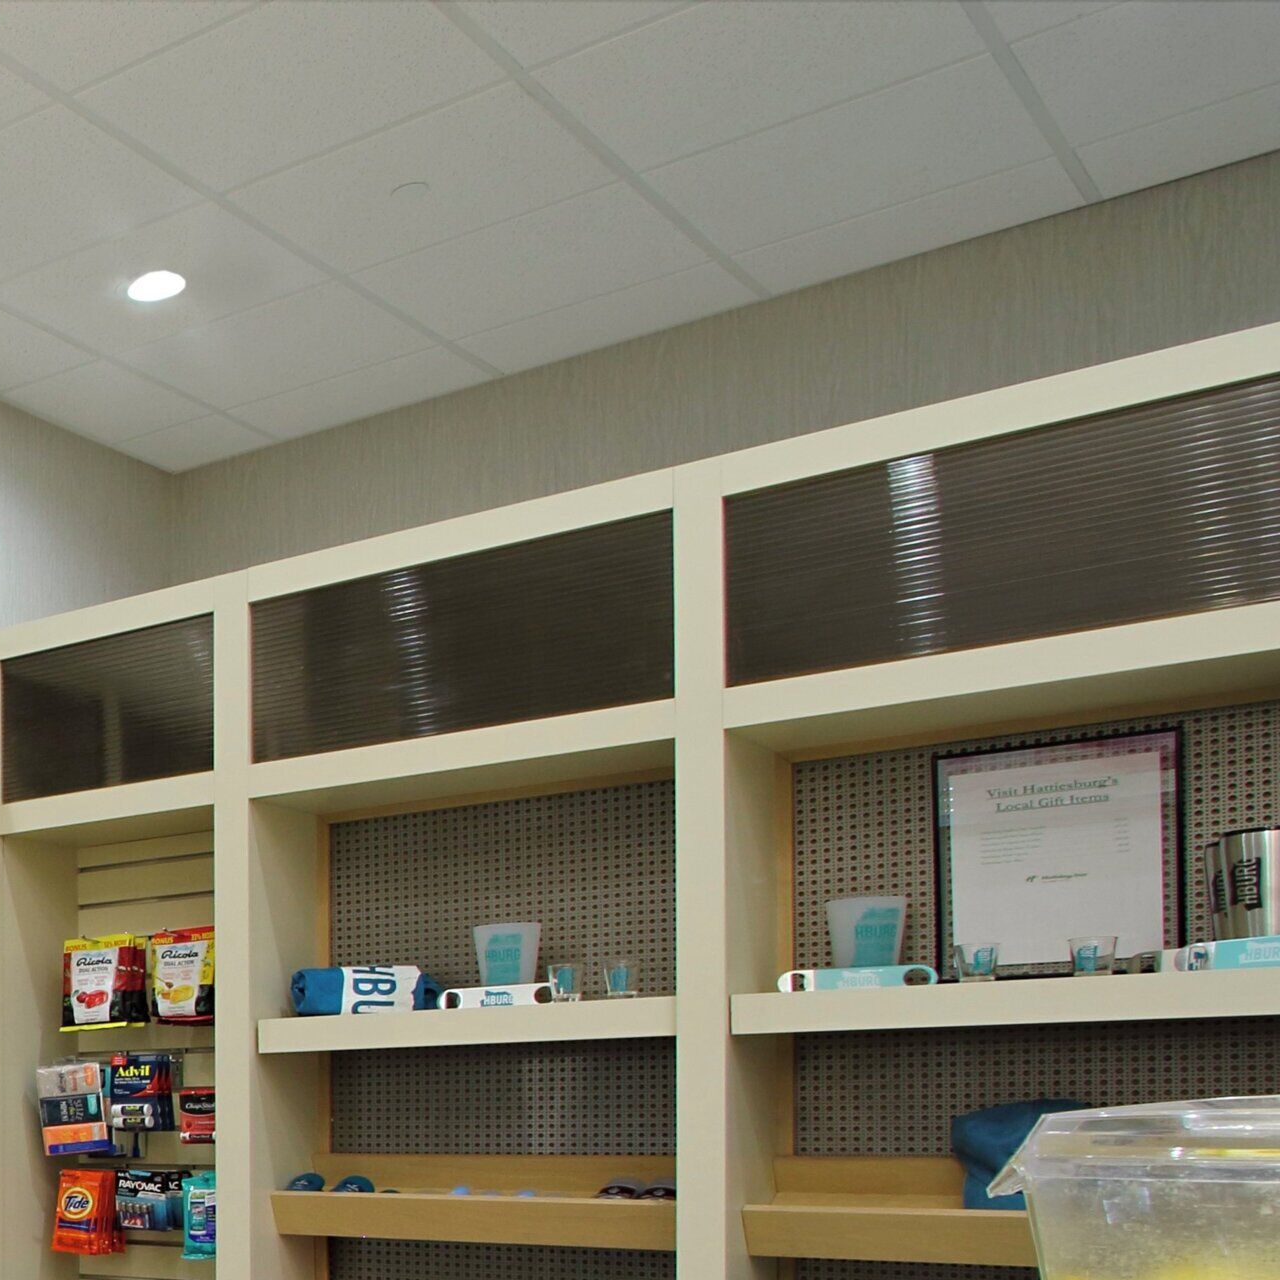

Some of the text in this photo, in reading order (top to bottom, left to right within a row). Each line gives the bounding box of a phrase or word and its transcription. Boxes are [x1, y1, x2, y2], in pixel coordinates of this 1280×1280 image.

[986, 776, 1119, 799] Visit Hattiesburg's
[996, 794, 1110, 813] Local Gift Items
[65, 944, 87, 952] BONUS
[161, 949, 199, 959] Ricola
[76, 957, 112, 966] Ricola
[115, 1065, 151, 1077] Advil
[119, 1179, 162, 1192] RAYOVAC
[65, 1195, 89, 1211] Tide
